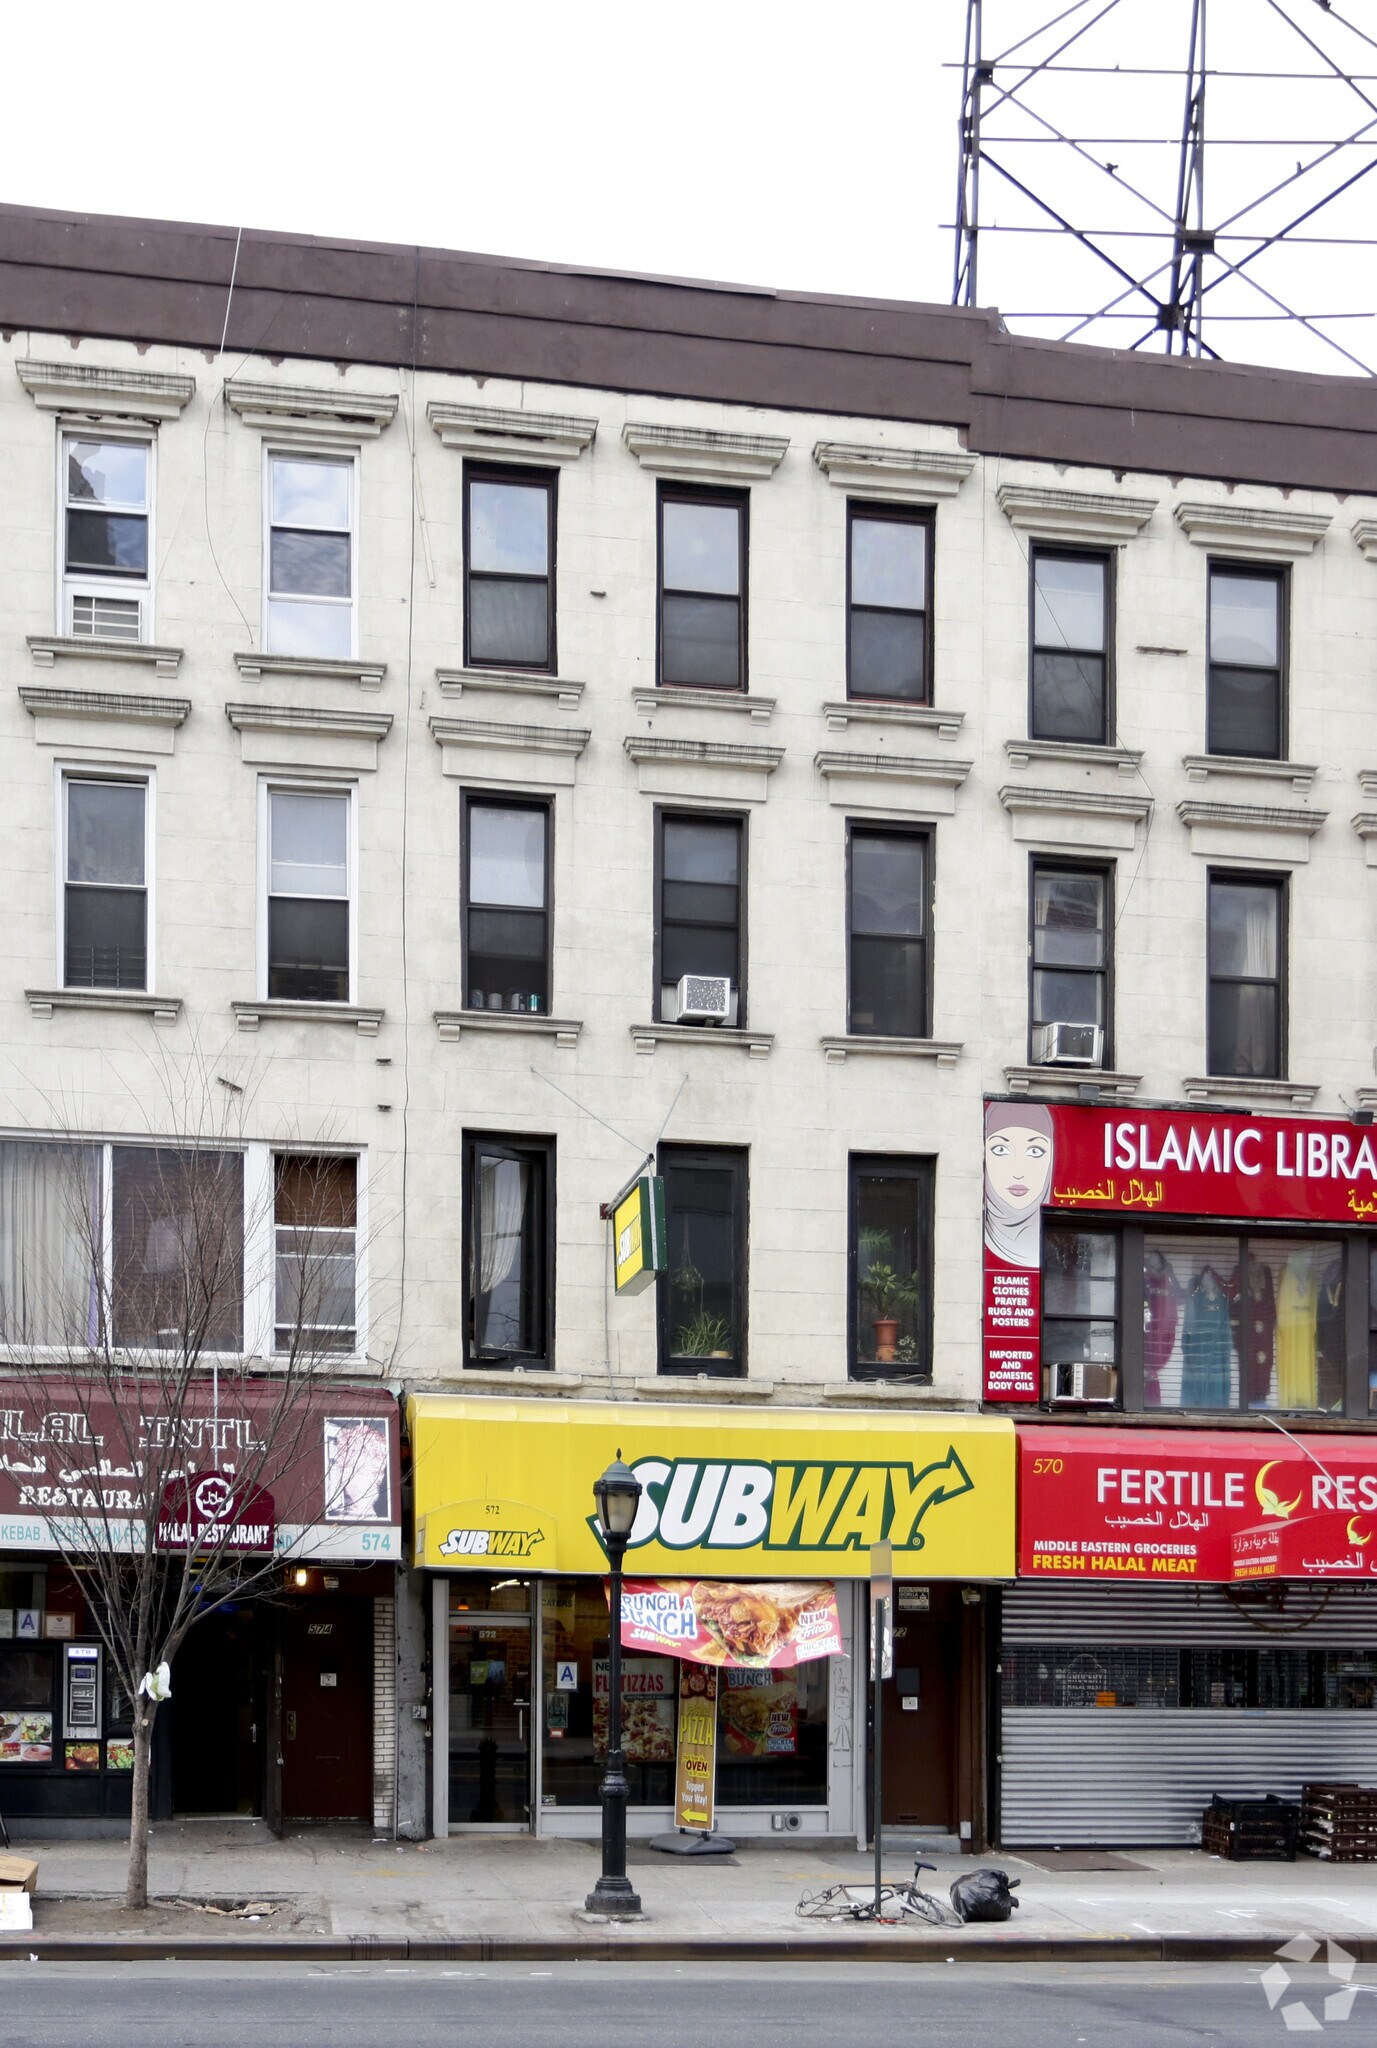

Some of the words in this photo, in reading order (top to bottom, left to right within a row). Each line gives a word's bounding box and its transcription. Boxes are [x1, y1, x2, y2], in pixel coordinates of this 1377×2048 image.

[1103, 1122, 1261, 1177] ISLAMIC
[1053, 1179, 1115, 1206] الخصيب
[1121, 1179, 1163, 1207] الهلال
[1347, 1188, 1377, 1220] مية
[993, 1276, 1029, 1286] ISLAMIC
[992, 1286, 1030, 1296] CLOTHES
[994, 1297, 1028, 1306] PRAYER
[987, 1307, 1012, 1316] RUGS
[1014, 1308, 1034, 1317] AND
[992, 1317, 1030, 1327] POSTERS
[989, 1350, 1033, 1360] IMPORTED
[1000, 1361, 1021, 1370] AND
[989, 1371, 1033, 1380] DOMESTIC
[987, 1381, 1012, 1391] BODY
[1014, 1381, 1034, 1391] OILS
[0, 1409, 104, 1446] LAL
[1032, 1458, 1064, 1475] 570
[1096, 1467, 1244, 1508] FERTILE
[1311, 1474, 1377, 1512] RES
[19, 1485, 155, 1510] RESTAURA
[588, 1447, 974, 1552] SUBWAY
[485, 1505, 500, 1515] 572
[1104, 1510, 1163, 1530] الخصيب
[1169, 1510, 1209, 1532] الهلال
[124, 1527, 148, 1546] FOO
[158, 1522, 195, 1543] HALAL
[361, 1533, 391, 1552] 574
[439, 1529, 545, 1557] SUBWAY
[1033, 1540, 1078, 1551] MIDDLE
[1080, 1541, 1130, 1553] EASTERN
[1133, 1543, 1197, 1555] GROCERIES
[1032, 1555, 1085, 1570] FRESH
[1091, 1556, 1146, 1572] HALAL
[1151, 1558, 1197, 1573] MEAT
[1302, 1551, 1364, 1574] الخصيب
[1234, 1567, 1248, 1577] FRESH
[1248, 1566, 1263, 1575] HALAL
[1263, 1564, 1276, 1573] MEAT
[685, 1601, 693, 1611] A
[21, 1613, 35, 1630] A
[800, 1610, 827, 1625] NEW
[307, 1623, 333, 1634] 574
[479, 1630, 497, 1639] 572
[799, 1624, 832, 1641] Fritos
[893, 1627, 907, 1637] 72
[797, 1637, 838, 1653] CHICKEN
[561, 1666, 574, 1682] A
[595, 1662, 627, 1672] NE!
[595, 1674, 664, 1693] FLTIZZAS
[728, 1673, 772, 1687] BUNCH
[772, 1713, 789, 1722] NEW
[679, 1716, 713, 1746] PIZZA
[685, 1759, 708, 1772] OVEN
[685, 1780, 705, 1793] Topped
[681, 1792, 695, 1803] Your
[695, 1793, 708, 1806] Way!
